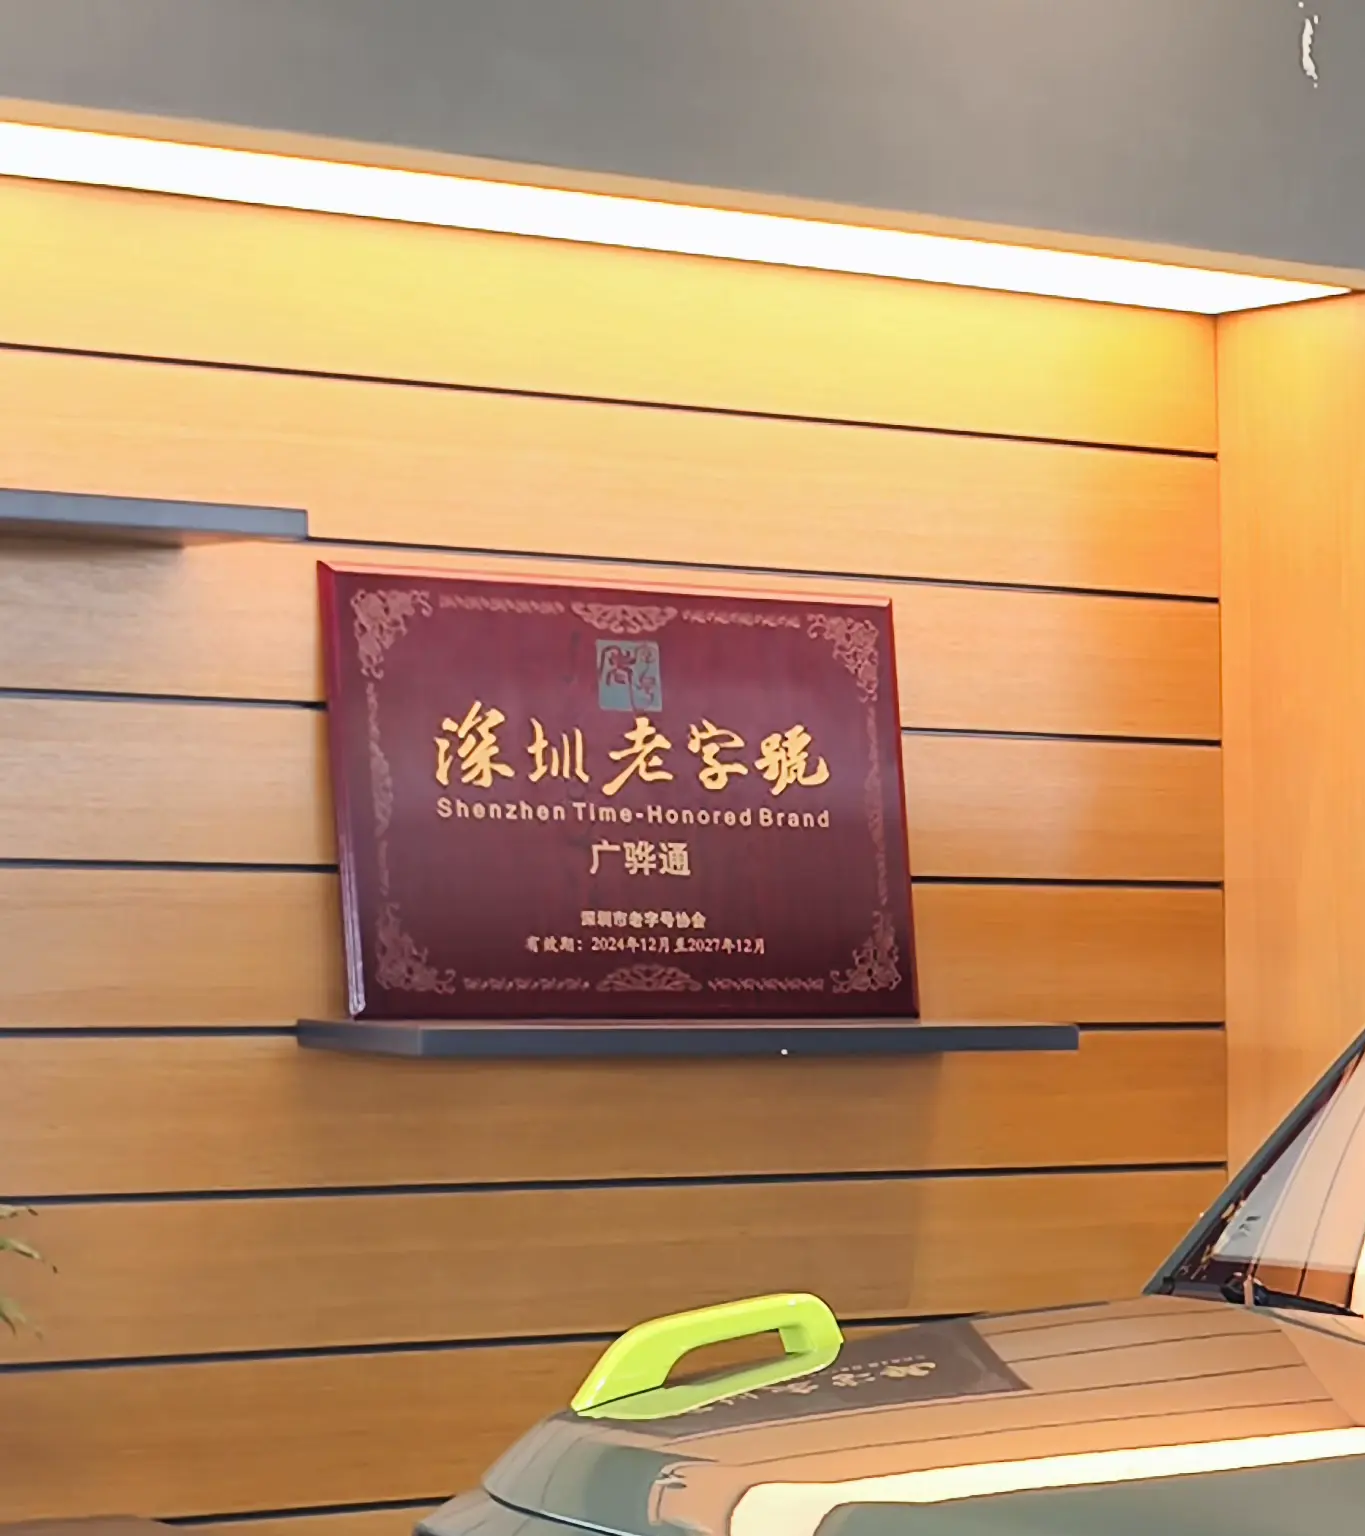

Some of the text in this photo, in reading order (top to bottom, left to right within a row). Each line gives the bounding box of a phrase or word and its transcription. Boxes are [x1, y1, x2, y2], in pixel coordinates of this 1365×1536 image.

[436, 797, 830, 829] Shenzhen Time-Honored Brand
[589, 839, 692, 877] 广骅通
